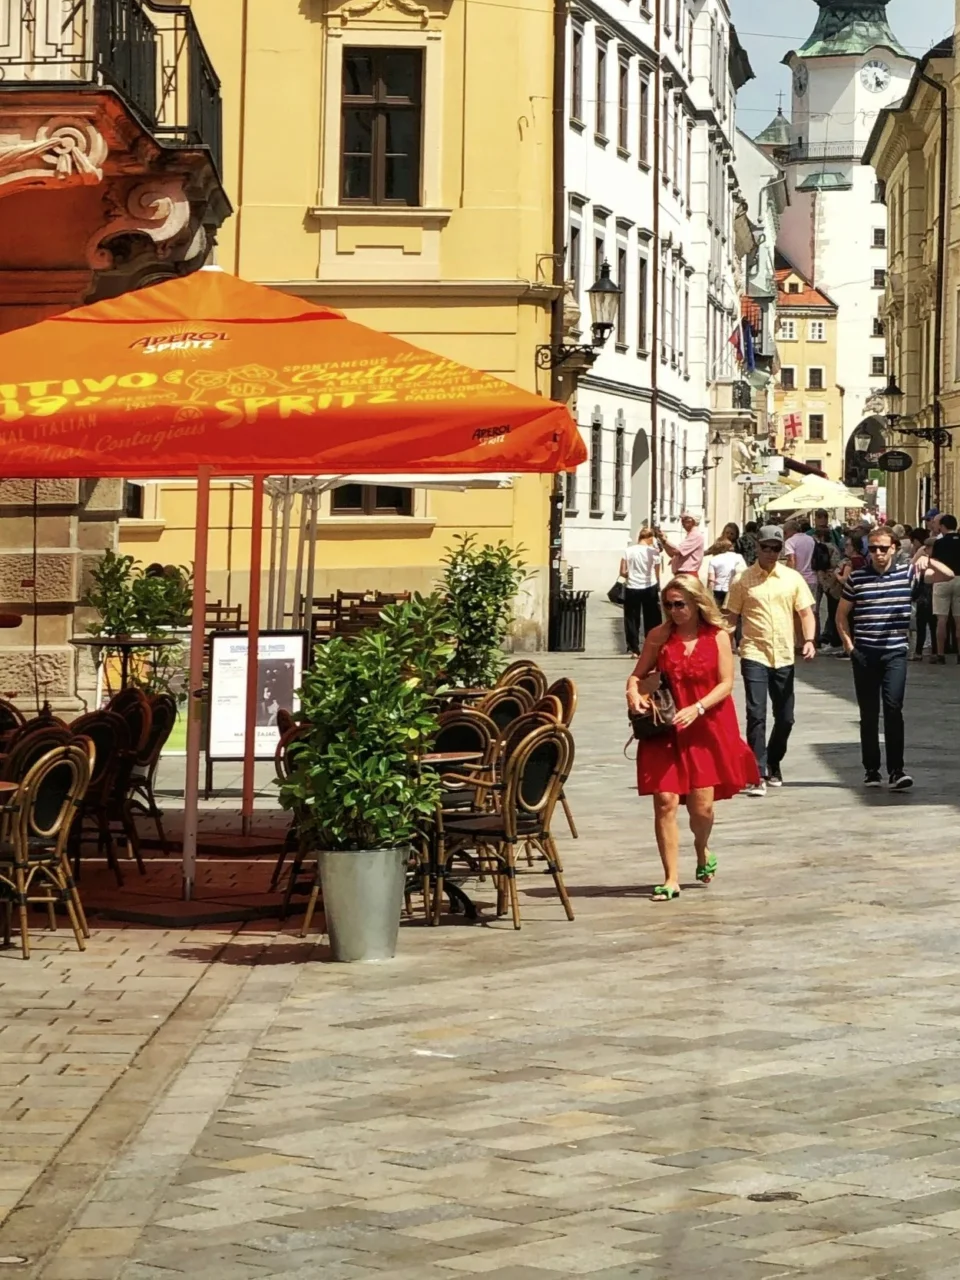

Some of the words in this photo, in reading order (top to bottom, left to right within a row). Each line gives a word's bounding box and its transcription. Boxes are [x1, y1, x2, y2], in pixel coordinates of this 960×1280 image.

[128, 331, 231, 349] APEROL
[142, 339, 214, 354] SPRITZ
[282, 357, 388, 372] SPONTANEOUS
[215, 390, 399, 429] SPRITZ
[471, 424, 512, 441] APEROL
